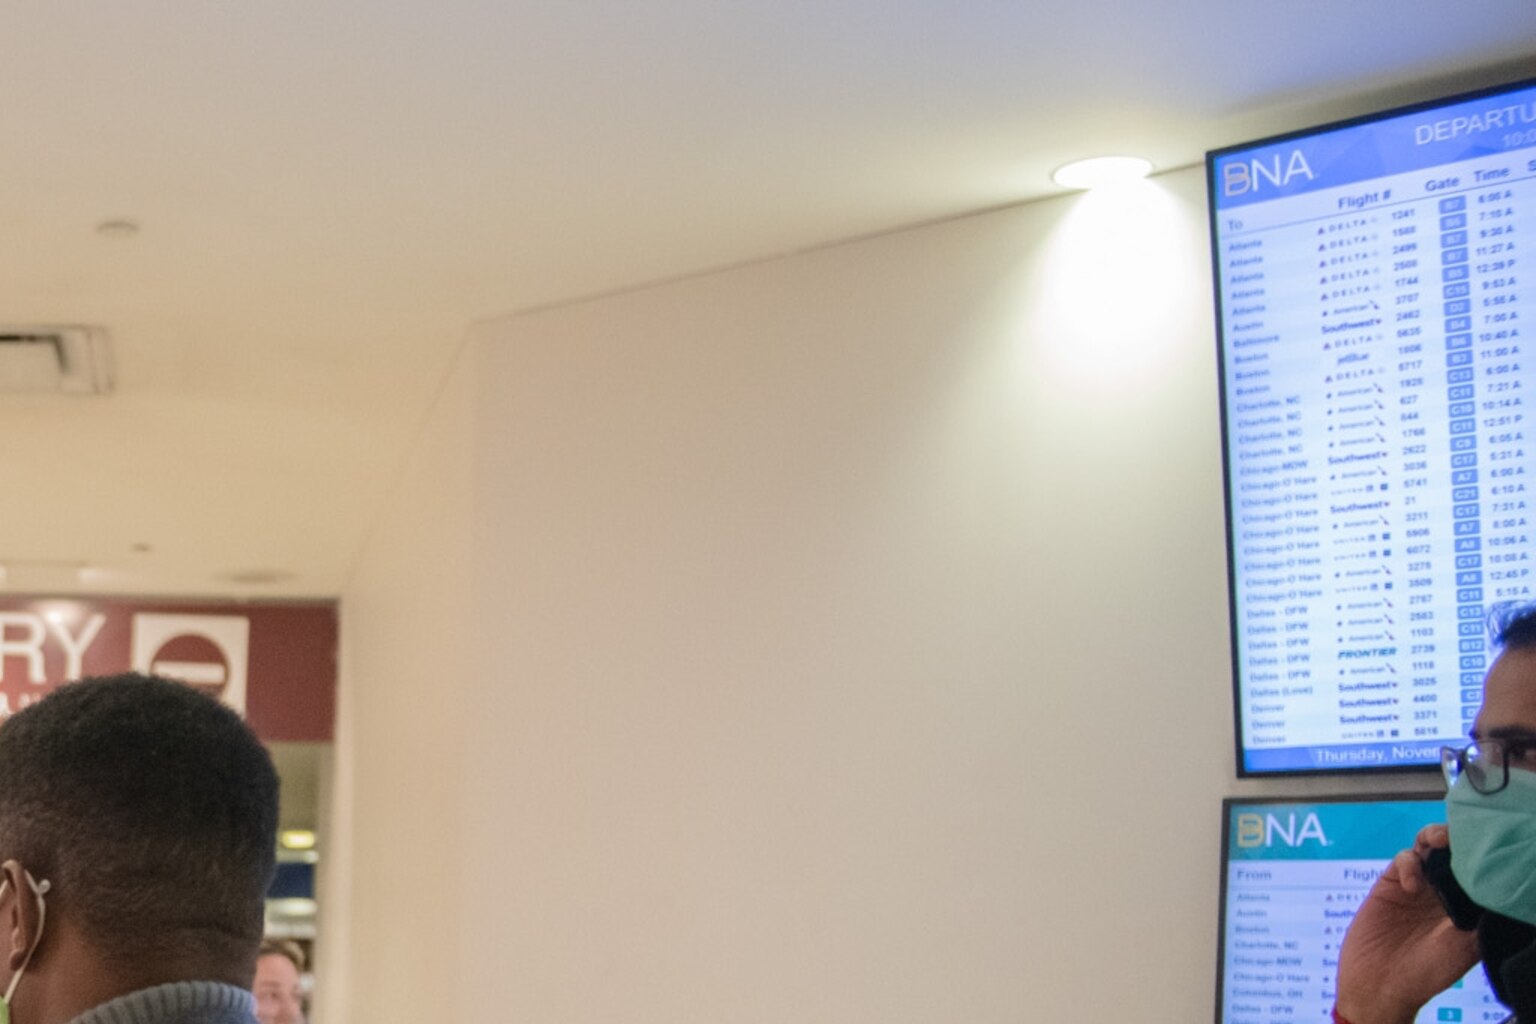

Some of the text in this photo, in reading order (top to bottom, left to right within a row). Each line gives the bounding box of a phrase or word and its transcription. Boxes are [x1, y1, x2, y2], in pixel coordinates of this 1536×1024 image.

[1223, 149, 1314, 197] BNA
[1227, 217, 1243, 231] To
[1337, 189, 1378, 211] Flight
[1382, 187, 1391, 201] #
[1424, 174, 1460, 193] Gate
[1474, 164, 1509, 183] Time
[1328, 218, 1366, 232] DELTA
[1329, 235, 1367, 249] DELTA
[1330, 251, 1368, 265] DELTA
[1331, 241, 1515, 282] DELTA 11:27 A
[1331, 258, 1516, 299] DELTA 1744 P
[1508, 276, 1516, 286] A
[1321, 317, 1375, 334] Southwest
[1508, 293, 1517, 303] A
[1334, 335, 1371, 348] DELTA
[1509, 310, 1518, 321] A
[1510, 328, 1519, 338] A
[1335, 368, 1373, 381] DELTA
[1511, 345, 1519, 355] A
[1511, 362, 1520, 372] A
[1450, 387, 1471, 398] C11
[1512, 380, 1521, 390] A
[1482, 399, 1511, 411] 10:14
[1513, 397, 1522, 407] A
[1452, 421, 1472, 432] C11
[1514, 414, 1522, 424] P
[1327, 450, 1381, 465] Southwest
[1455, 438, 1471, 448] C9
[1514, 432, 1523, 441] A
[1453, 455, 1474, 466] C17
[1515, 449, 1524, 459] A
[1457, 472, 1472, 482] A7
[1516, 466, 1525, 476] A
[1329, 500, 1383, 514] Southwest
[1404, 495, 1416, 505] 21
[1455, 489, 1475, 499] C21
[1517, 483, 1525, 493] A
[1455, 506, 1476, 516] C17
[1517, 500, 1526, 510] A
[1459, 517, 1527, 533] A7 A
[1519, 535, 1528, 544] A
[1458, 552, 1528, 567] C17 A
[1520, 569, 1529, 578] P
[1459, 590, 1480, 600] C11
[1521, 586, 1530, 595] A
[1460, 607, 1480, 617] C13
[1460, 624, 1481, 634] C11
[1336, 647, 1397, 660] FRONTIER
[1338, 680, 1391, 692] Southwest
[1338, 696, 1392, 708] Southwest
[1413, 693, 1437, 703] 4400
[1339, 713, 1392, 724] Southwest
[1318, 747, 1384, 764] Thursday,
[1237, 812, 1329, 848] BNA
[1237, 869, 1272, 880] From
